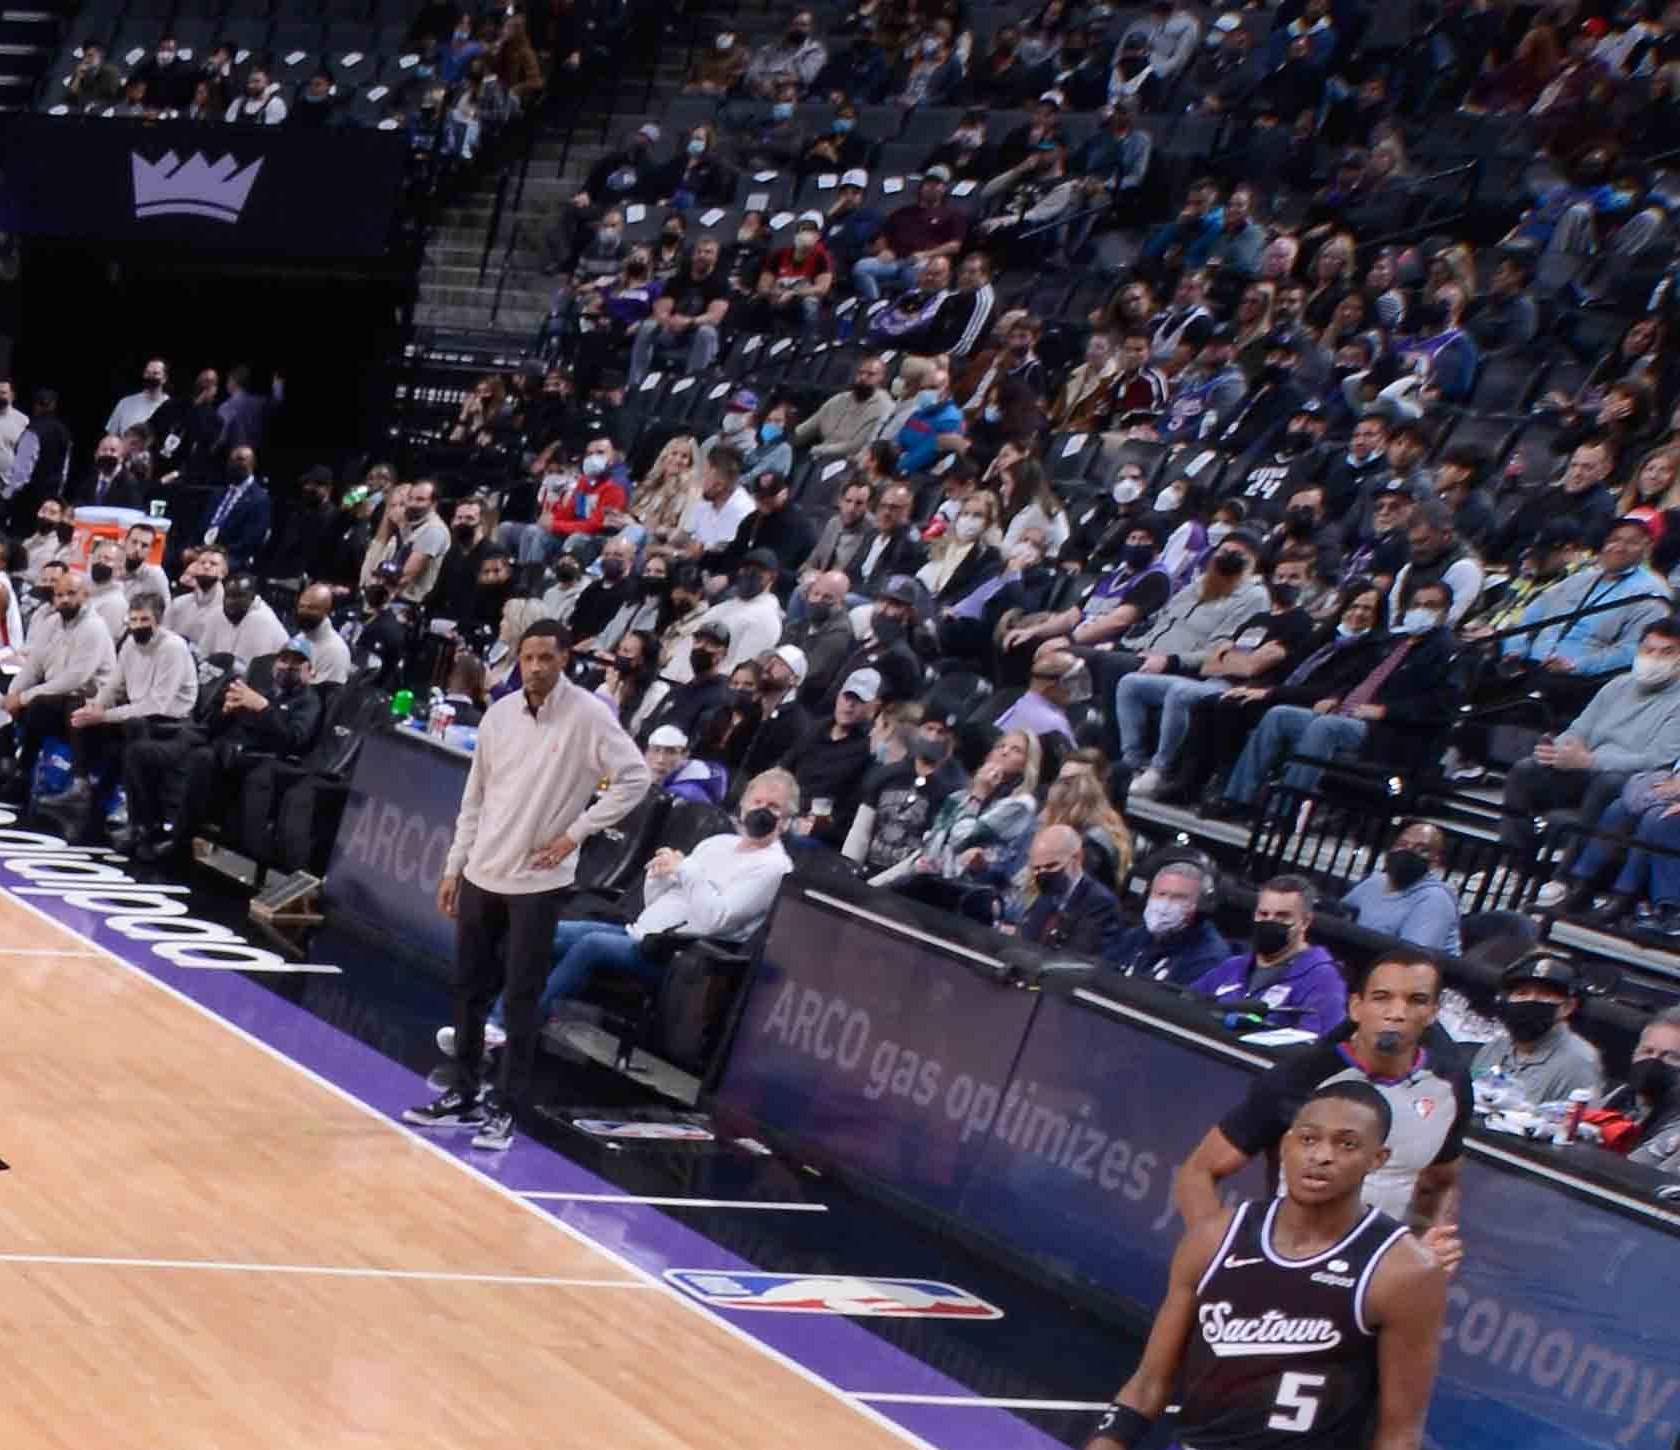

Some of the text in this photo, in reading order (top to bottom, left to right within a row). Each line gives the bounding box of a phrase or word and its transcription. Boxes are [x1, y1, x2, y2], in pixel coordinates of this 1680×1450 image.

[762, 981, 871, 1070] ARCO
[862, 1039, 943, 1107] gas
[945, 1074, 1157, 1201] optimizes
[1199, 1301, 1342, 1357] Sactown
[1442, 1286, 1672, 1447] conomy.
[1268, 1371, 1327, 1432] 5
